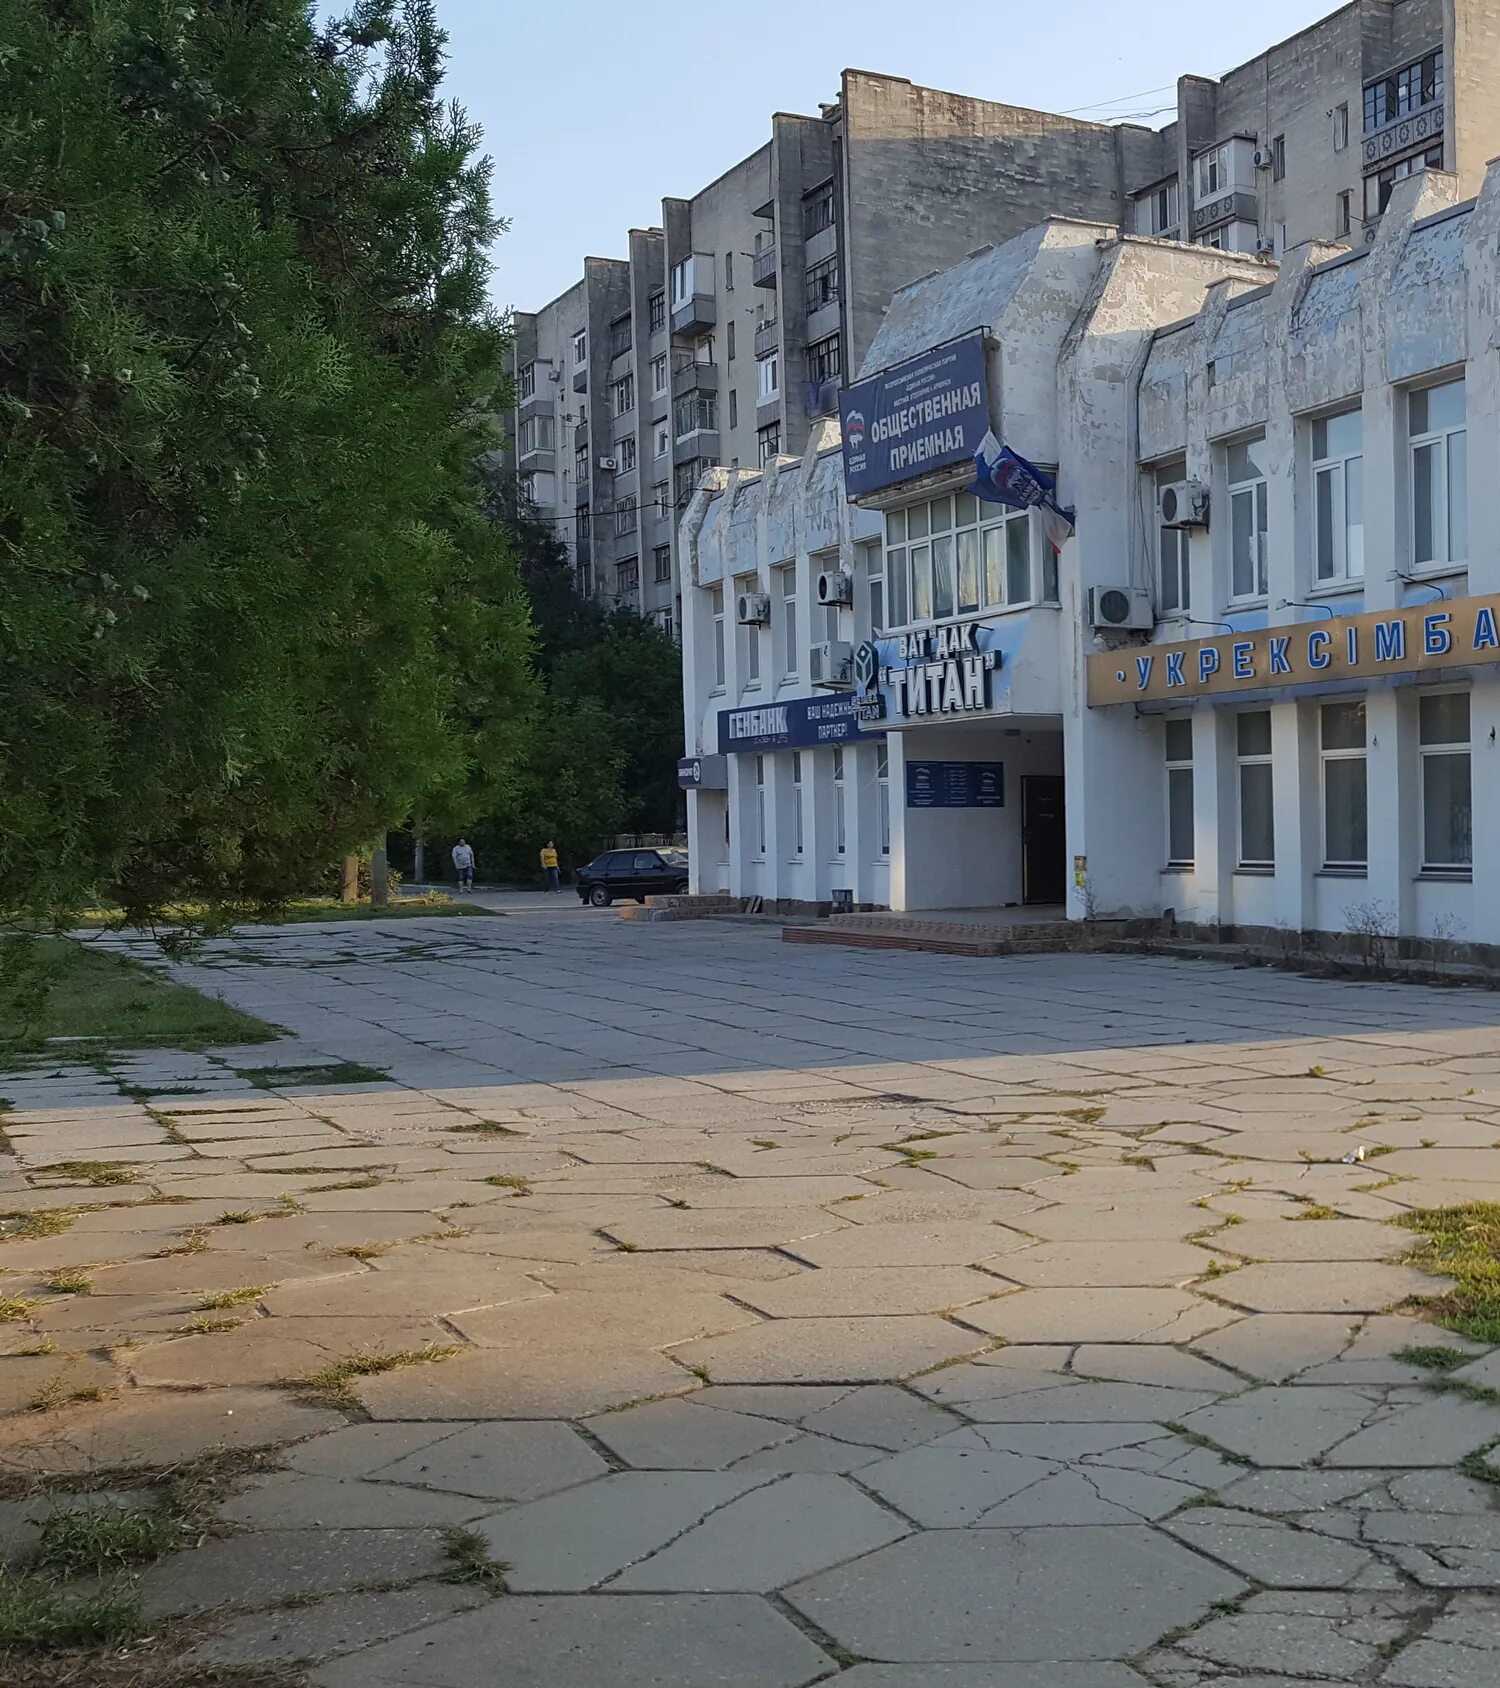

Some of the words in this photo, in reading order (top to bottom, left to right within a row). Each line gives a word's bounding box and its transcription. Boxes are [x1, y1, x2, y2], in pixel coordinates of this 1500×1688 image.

[871, 382, 981, 443] ОБЩЕСТВЕННАЯ
[890, 425, 964, 470] ПРИЕМНАЯ
[900, 632, 927, 660] ВАТ
[729, 706, 788, 739] ГЕНБАНК
[807, 705, 821, 720] ВАШ
[852, 705, 880, 720] TITAN
[818, 723, 848, 739] ПАРТНЕР!
